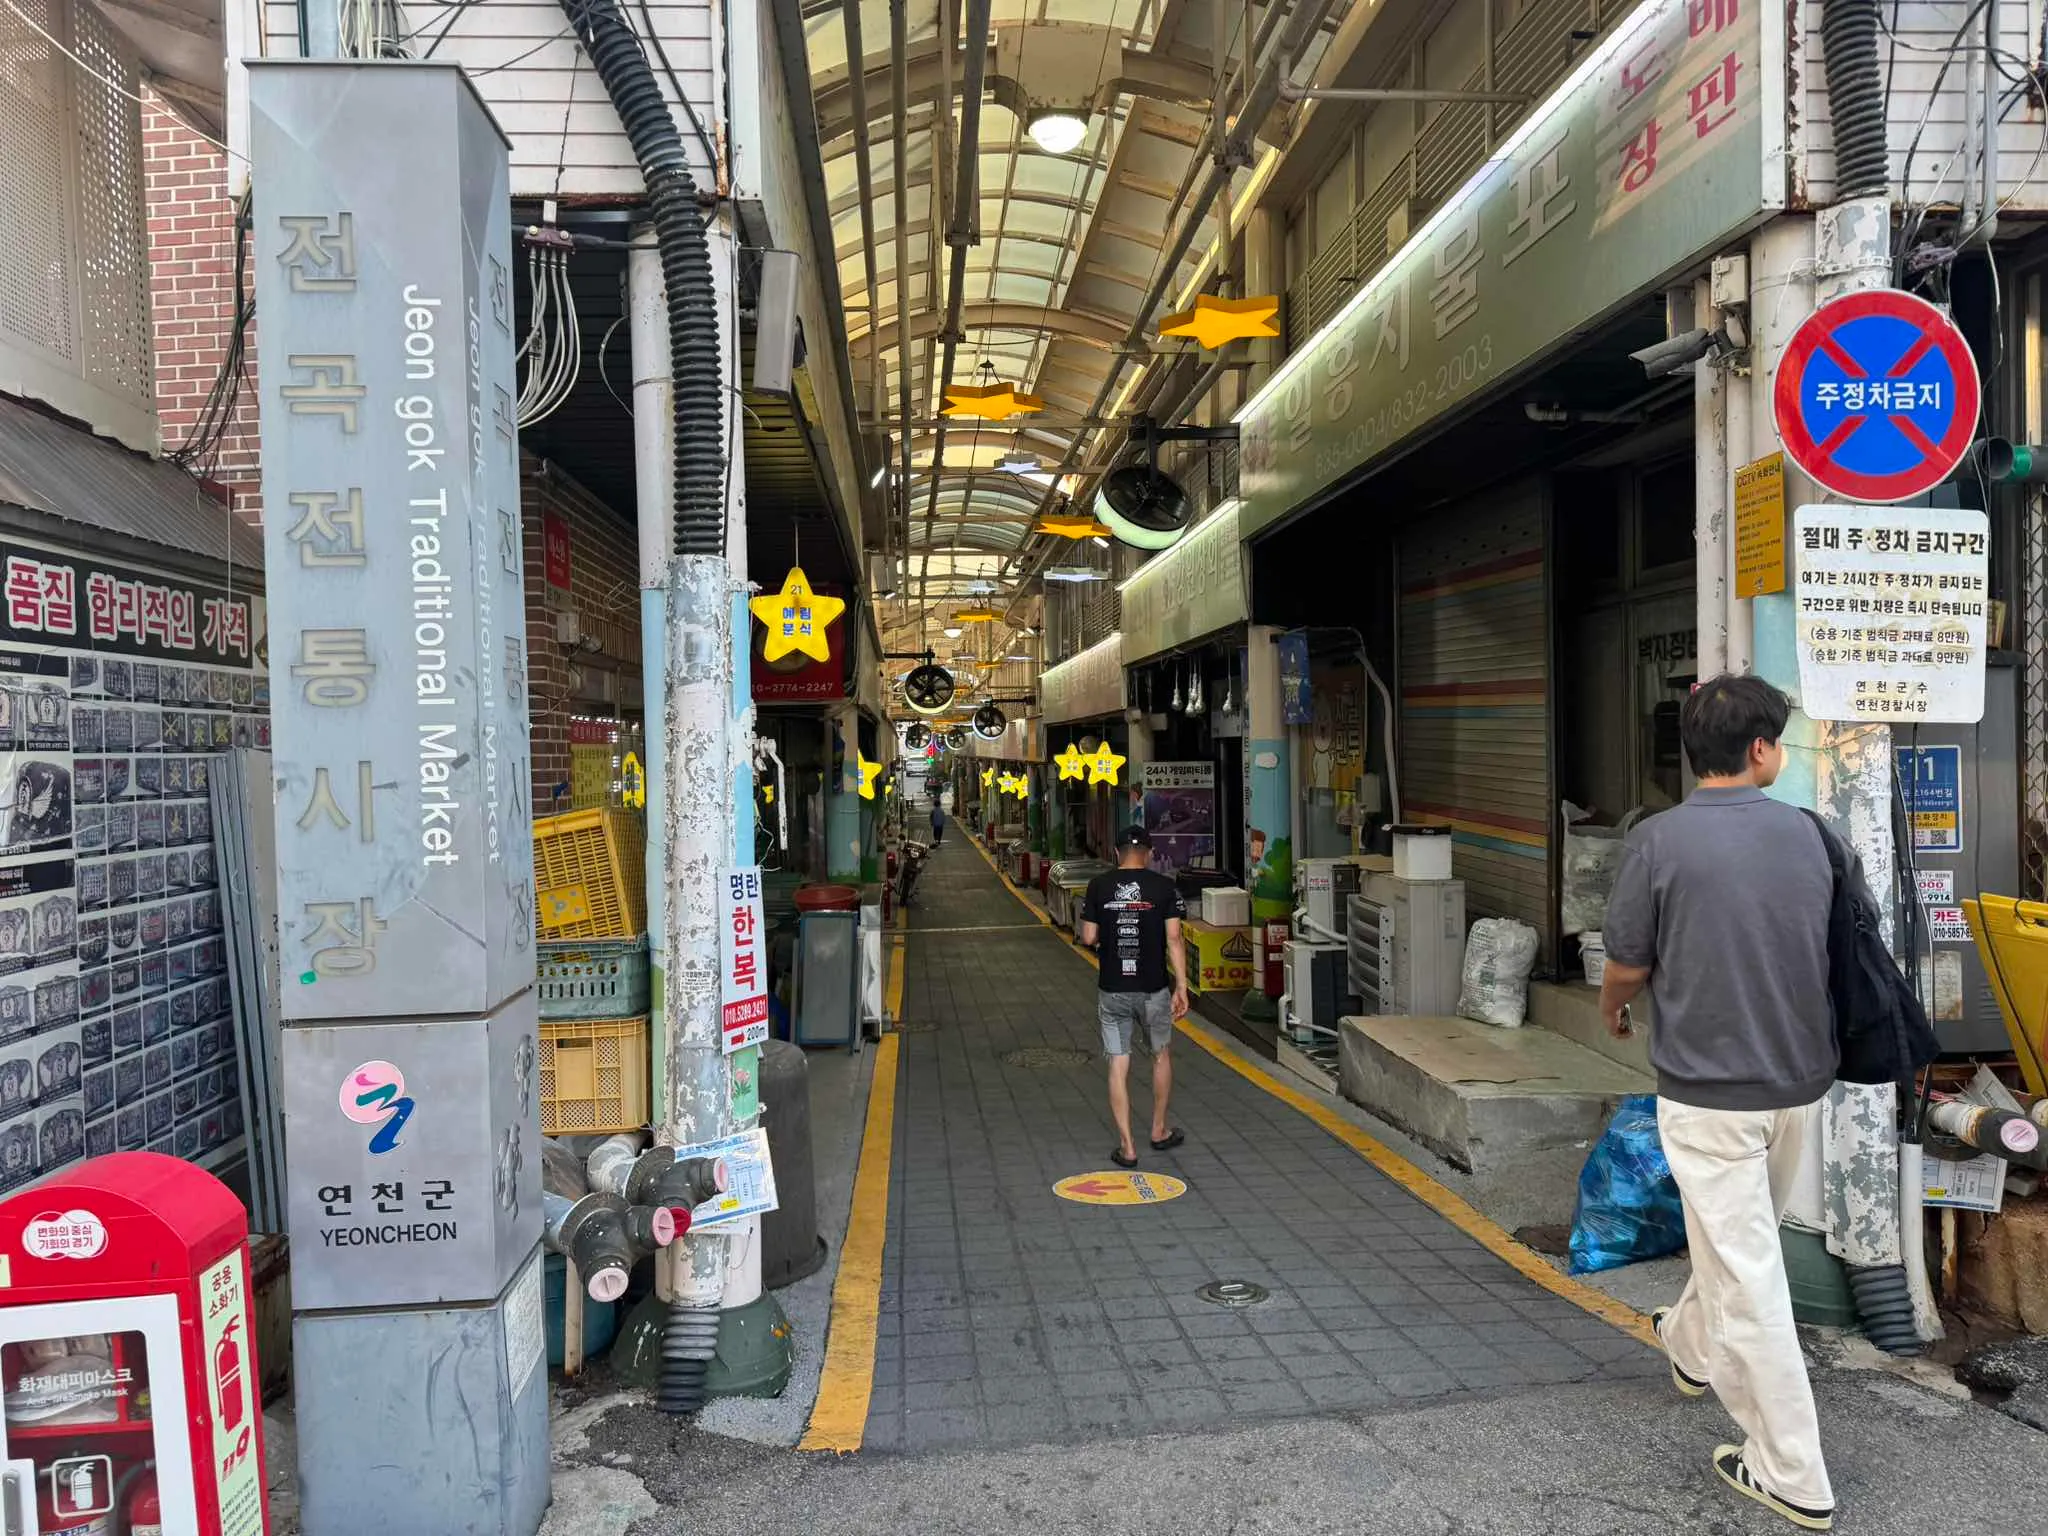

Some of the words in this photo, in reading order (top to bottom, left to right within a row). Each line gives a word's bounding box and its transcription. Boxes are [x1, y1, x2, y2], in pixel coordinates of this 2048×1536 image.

[1616, 51, 1744, 193] 장판
[402, 284, 442, 380] Jeon
[467, 296, 482, 391] Jeon
[1815, 381, 1942, 411] 주정차금지
[395, 394, 446, 472] gok
[1803, 527, 1840, 550] 절대
[1916, 532, 1985, 555] 금지구간
[790, 585, 803, 596] 21
[1802, 571, 1838, 586] 여기는
[1842, 571, 1880, 587] 24시간
[1938, 575, 1983, 591] 금지되는
[6, 556, 77, 636] 품질
[86, 573, 197, 653] 합리적인
[203, 595, 250, 658] 가격
[408, 487, 457, 706] Traditional
[475, 502, 497, 710] Traditional
[1802, 598, 1846, 613] 구간으로
[1848, 599, 1870, 613] 위반
[1872, 600, 1904, 615] 차량은
[1907, 600, 1928, 616] 즉시
[1931, 601, 1983, 617] 단속됩니다
[1810, 626, 1838, 642] (승용
[1841, 627, 1863, 642] 기준
[1866, 628, 1900, 643] 범칙금
[1902, 629, 1934, 643] 과태료
[1937, 630, 1970, 645] 8만원)
[1840, 648, 1862, 664] 기준
[1866, 648, 1899, 664] 범칙금
[1901, 649, 1934, 664] 과태료
[1936, 649, 1970, 665] 9만원)
[1855, 699, 1929, 713] 연천경찰서장
[1145, 765, 1168, 776] 24시
[418, 723, 461, 868] Market
[482, 725, 500, 867] Market
[730, 872, 758, 901] 명란
[731, 904, 758, 992] 한복
[37, 1225, 69, 1239] 변화의
[71, 1224, 93, 1236] 중심
[39, 1238, 71, 1250] 기회의
[72, 1237, 93, 1249] 경기
[320, 1221, 458, 1248] YEONCHEON
[211, 1263, 233, 1293] 공용
[208, 1284, 239, 1320] 소화기
[18, 1367, 134, 1394] 화재대피마스크
